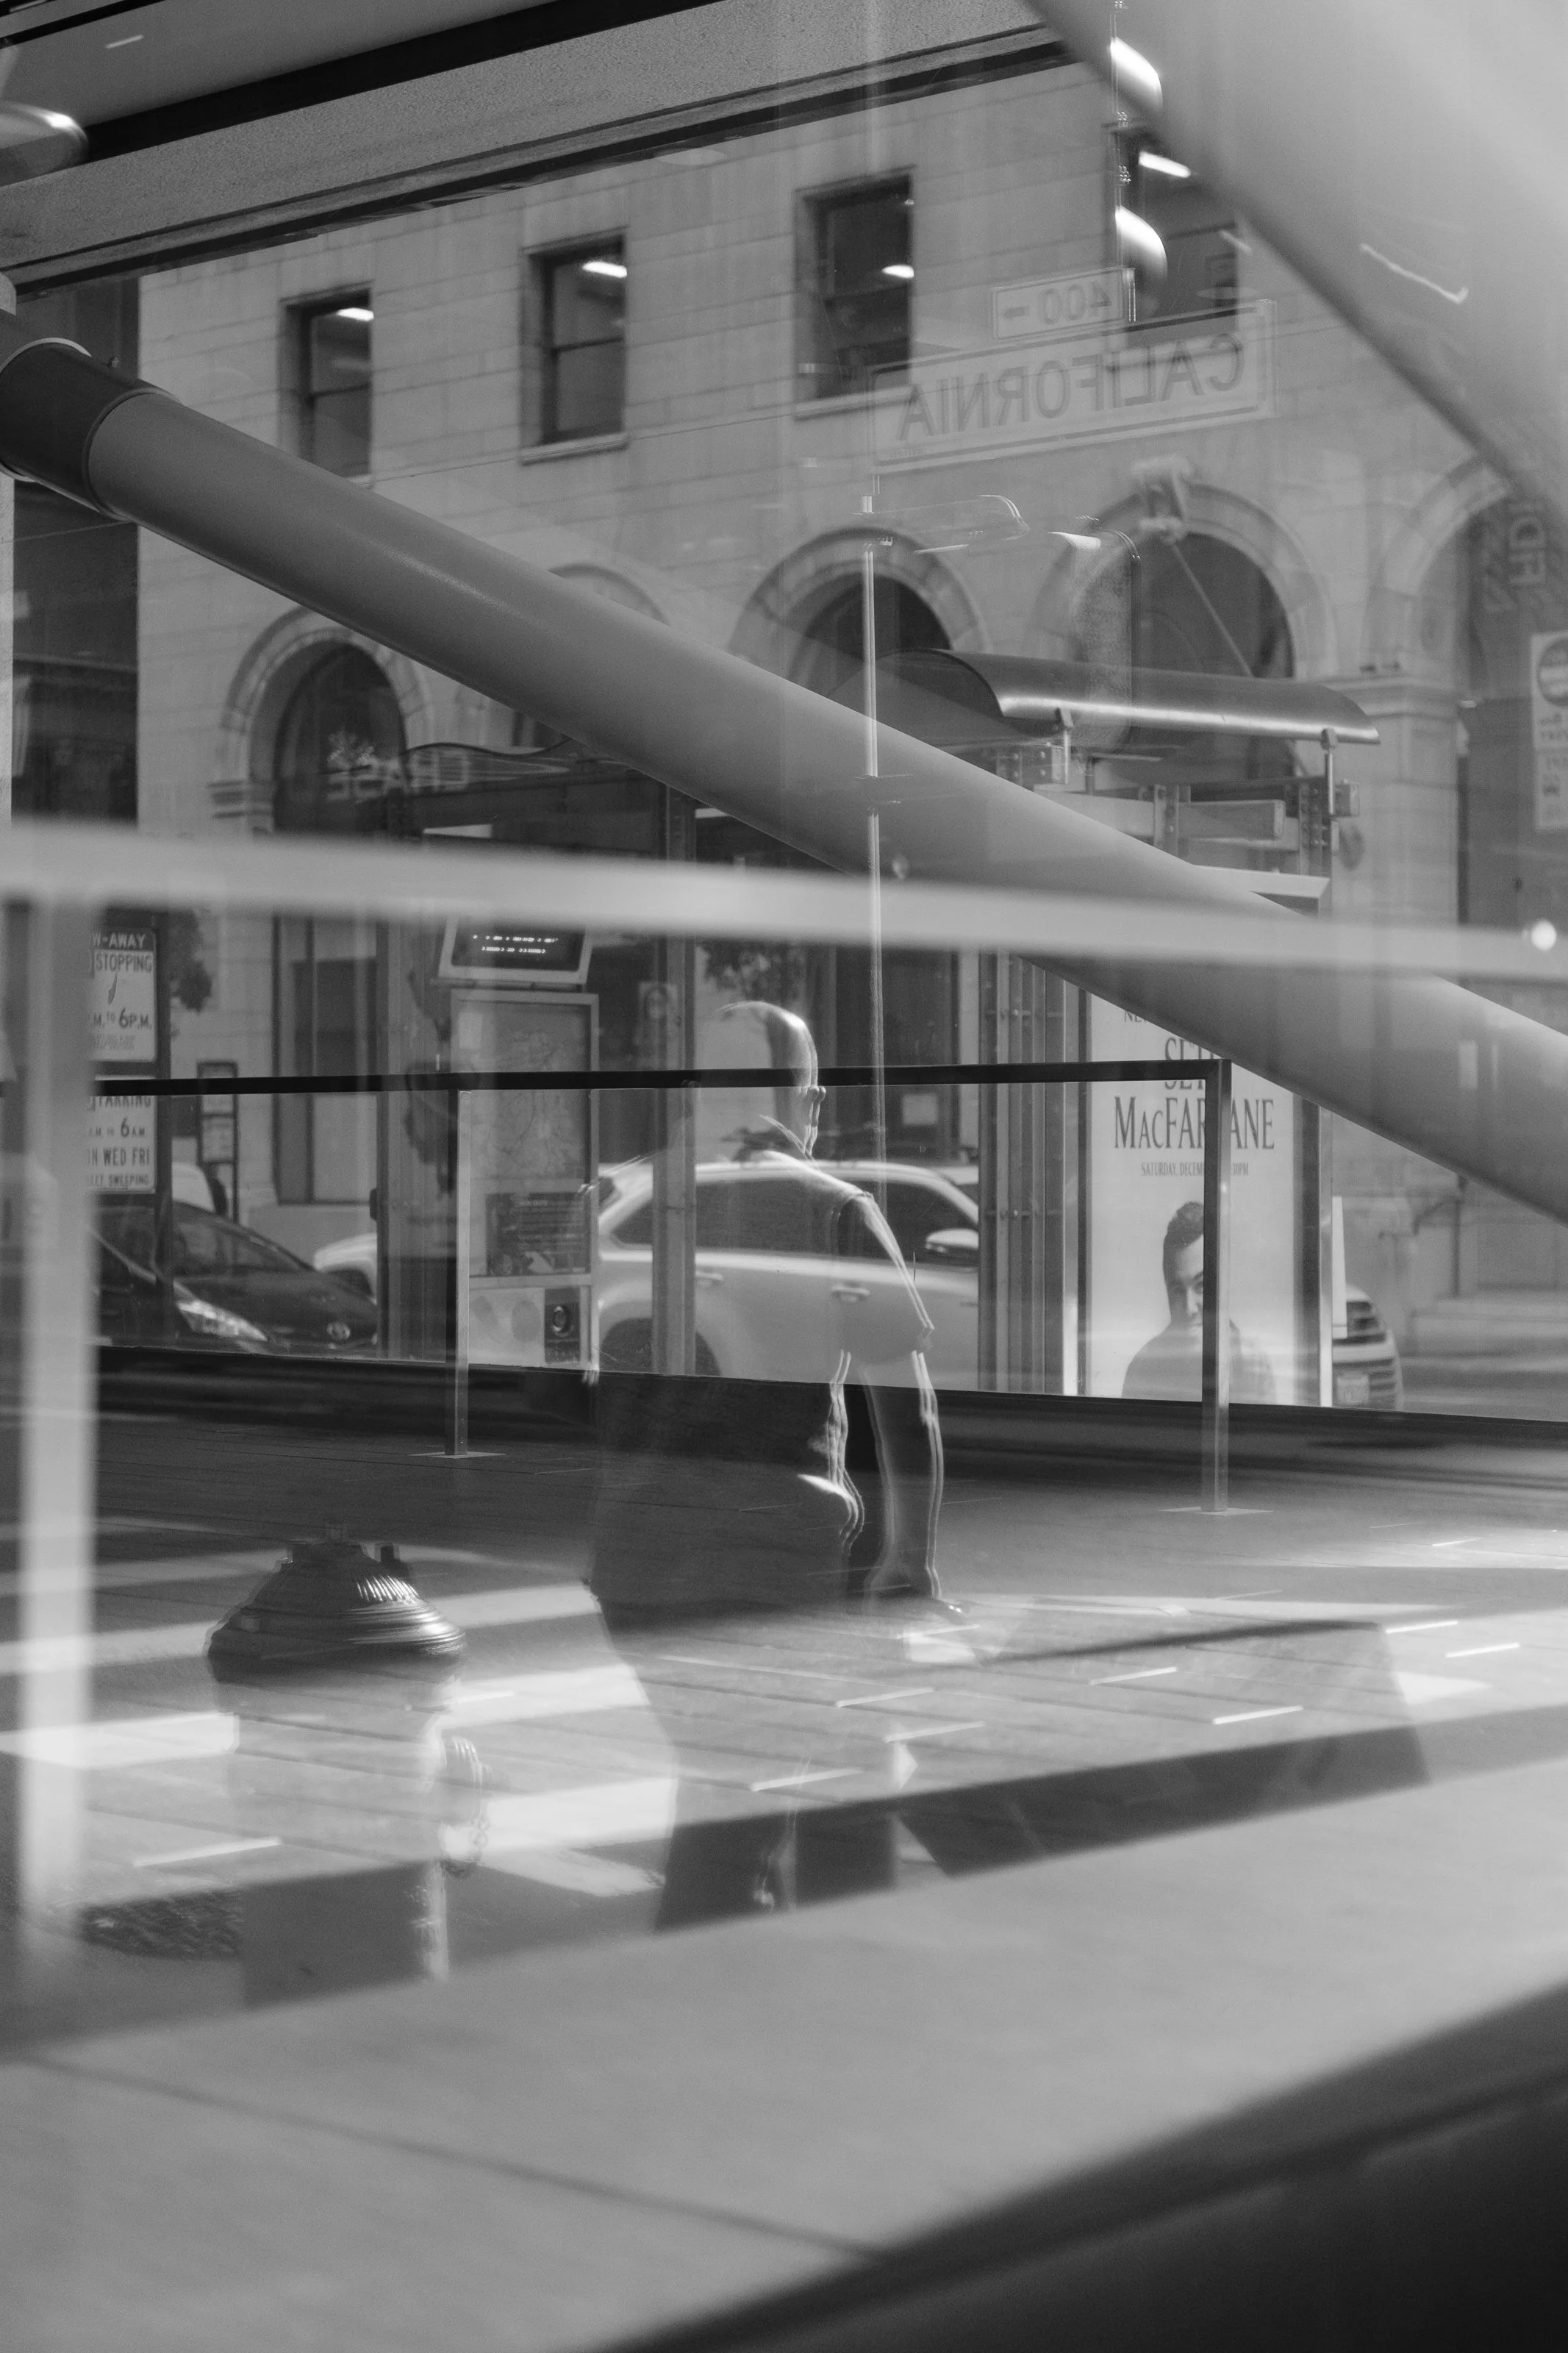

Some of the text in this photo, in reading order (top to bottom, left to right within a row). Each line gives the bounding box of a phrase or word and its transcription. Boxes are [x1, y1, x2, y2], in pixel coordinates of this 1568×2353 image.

[96, 953, 153, 974] STOPPING
[103, 1147, 127, 1166] WED
[132, 1147, 150, 1166] FRI
[1179, 1162, 1205, 1176] DECEM
